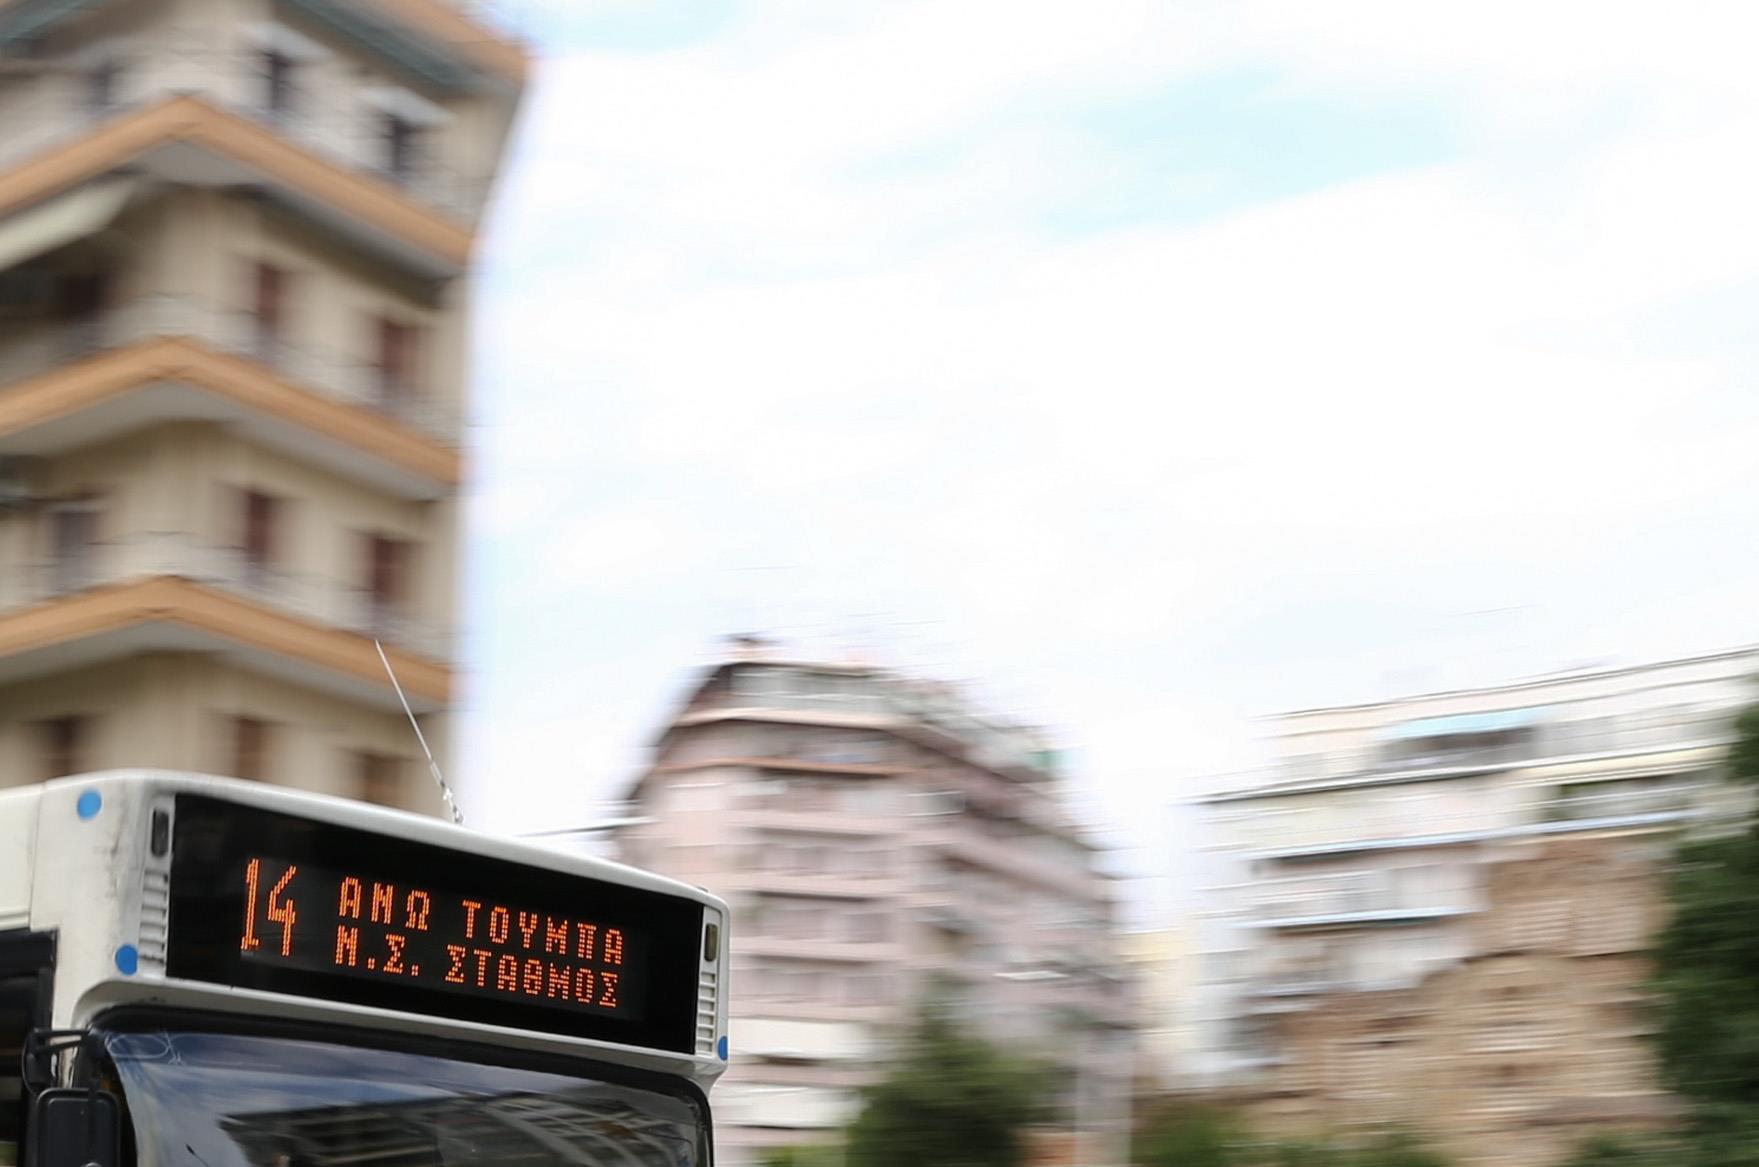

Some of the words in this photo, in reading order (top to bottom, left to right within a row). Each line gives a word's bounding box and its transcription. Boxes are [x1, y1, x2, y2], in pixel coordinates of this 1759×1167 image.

[240, 858, 297, 956] 14
[338, 876, 430, 931] ΑΝΩ
[461, 898, 624, 966] ΤΟΥΜΠΑ
[444, 943, 619, 1008] ΣΤΑΘΜΟΣ
